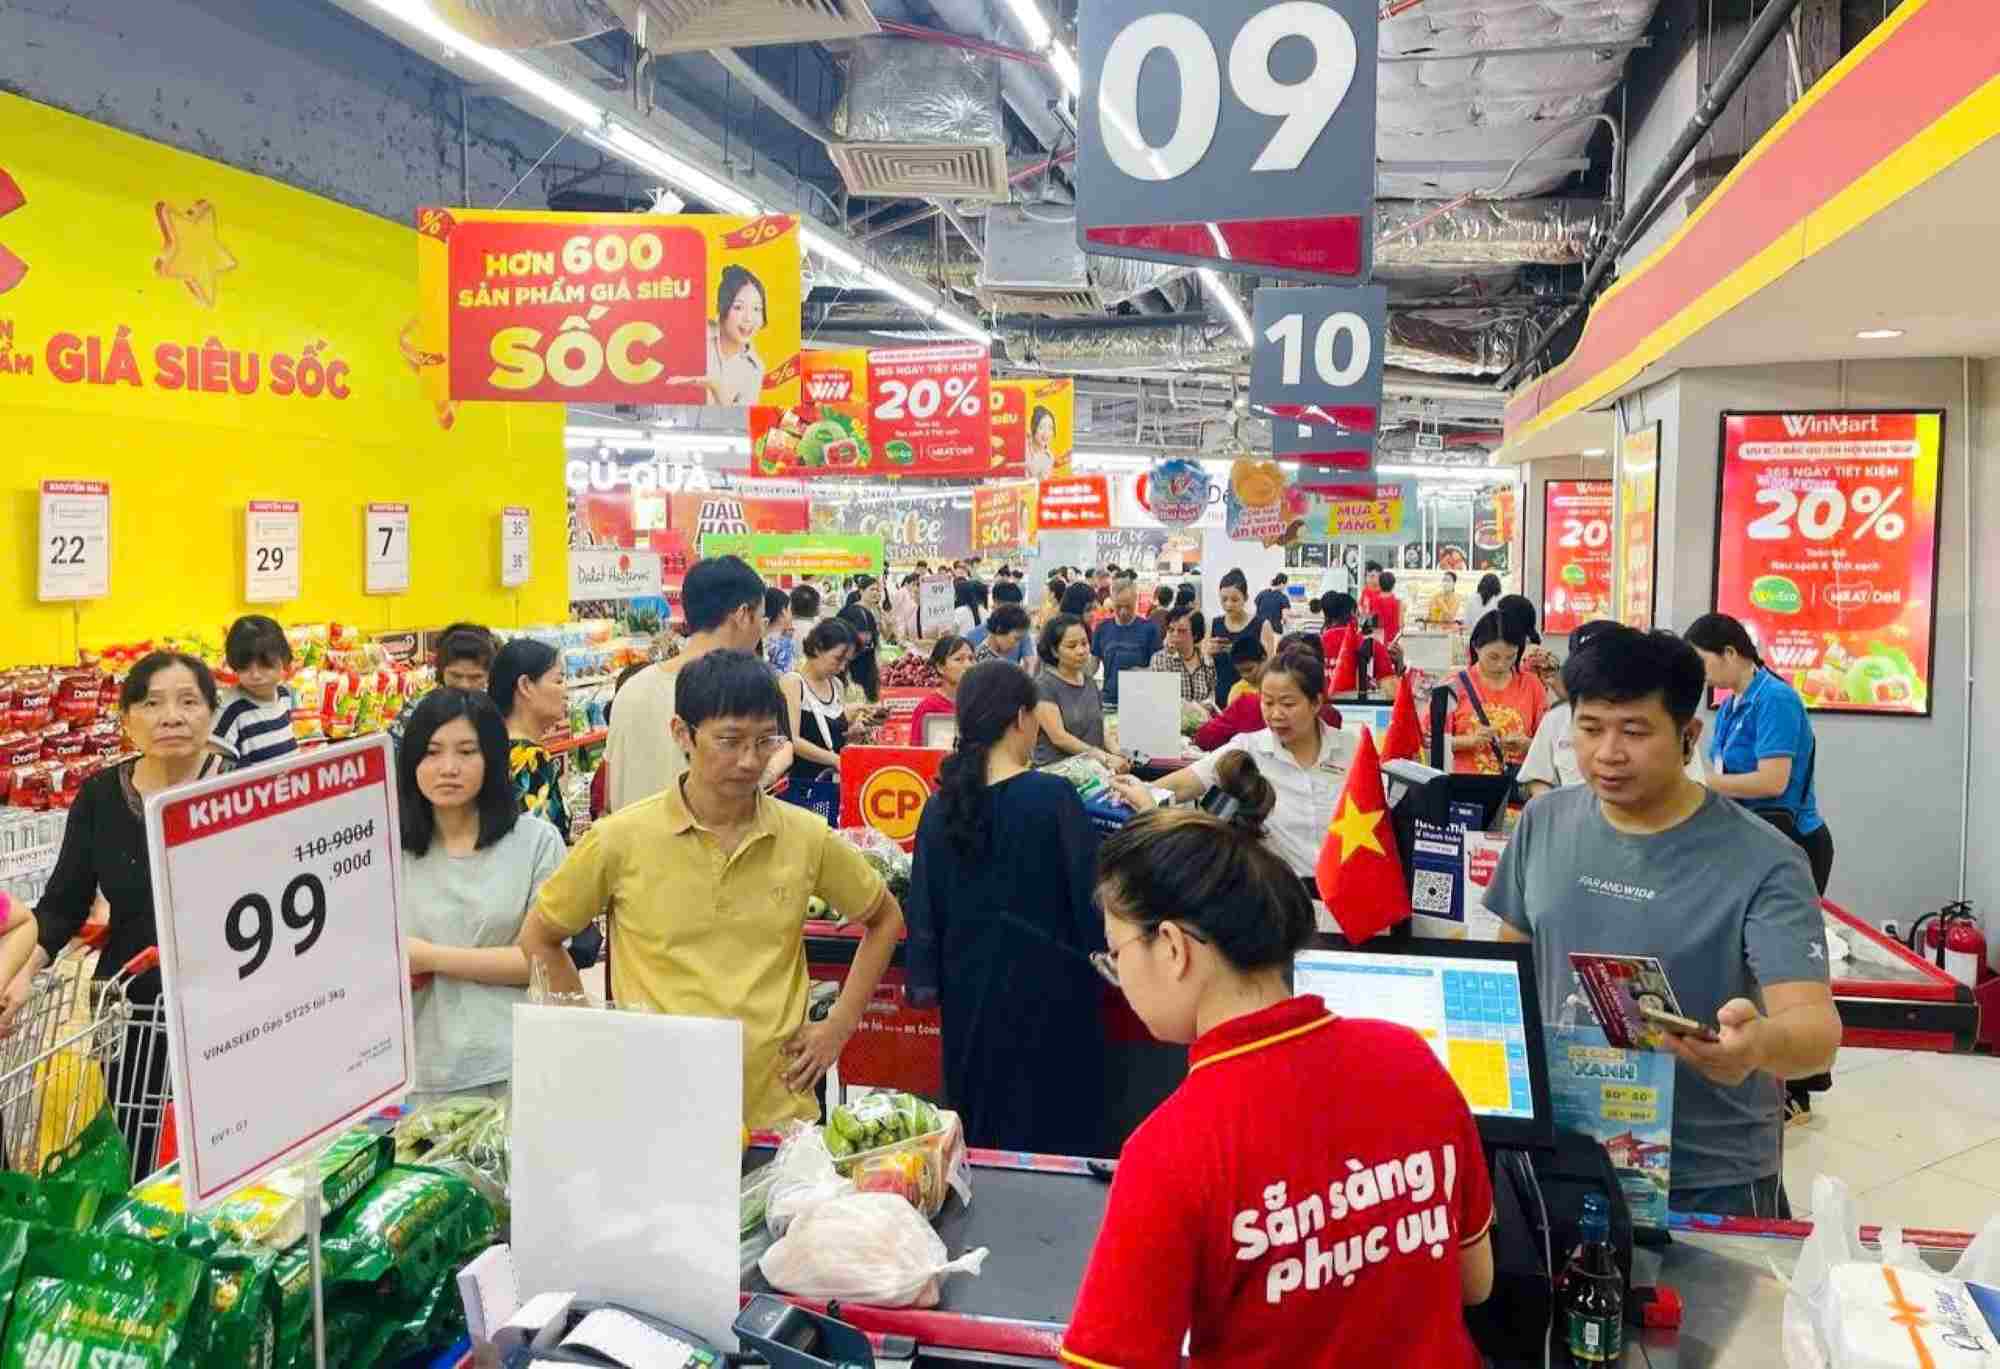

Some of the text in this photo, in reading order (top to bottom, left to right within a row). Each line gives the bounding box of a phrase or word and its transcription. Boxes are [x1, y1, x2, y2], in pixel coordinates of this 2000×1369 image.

[1097, 1, 1357, 181] 09
[485, 233, 663, 277] HƠN 600
[458, 275, 692, 307] SẢN PHẨM GIÁ SIÊU
[46, 324, 351, 400] GIÁ SIÊU SỐC
[487, 303, 665, 390] SỐC
[1264, 311, 1372, 387] 10
[874, 377, 981, 420] 20%
[1781, 415, 1879, 437] WinMart
[1747, 486, 1905, 541] 20%
[51, 536, 85, 565] 22
[256, 547, 284, 572] 29
[378, 527, 393, 557] 7
[188, 756, 366, 829] KHUYẾN MẠI
[870, 788, 921, 820] CP
[224, 872, 327, 981] 99
[1231, 1148, 1434, 1262] Sẵn sàng
[1265, 1203, 1451, 1305] phục vụ
